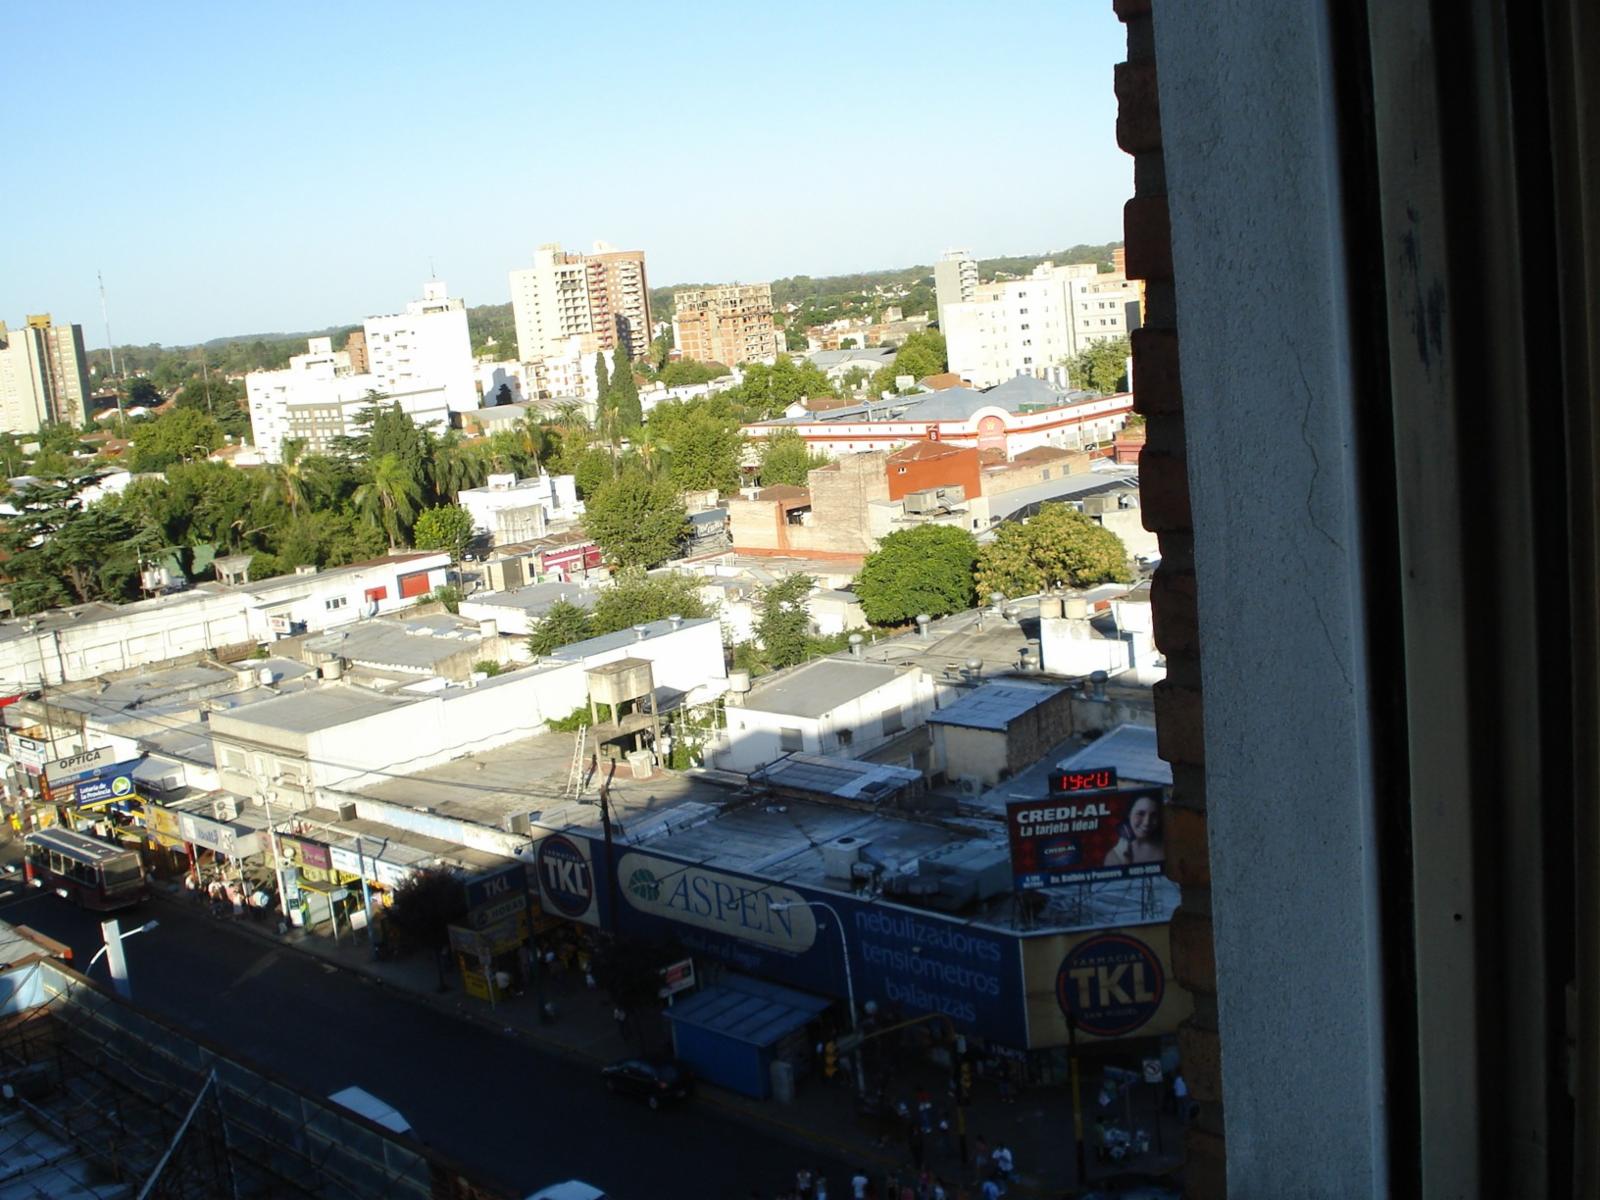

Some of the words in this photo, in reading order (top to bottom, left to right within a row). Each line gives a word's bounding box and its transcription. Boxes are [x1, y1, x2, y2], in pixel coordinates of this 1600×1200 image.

[60, 752, 101, 769] OPTICA
[1017, 803, 1111, 824] CREDI-AL
[1020, 825, 1032, 837] La
[1035, 821, 1070, 836] tarjeta
[1072, 818, 1098, 832] ideal
[482, 875, 511, 897] TKL
[543, 857, 589, 898] TKL
[667, 874, 794, 938] ASPEN
[855, 910, 1001, 961] nebulizadores
[1072, 952, 1145, 967] FARMACIAS
[884, 976, 977, 1022] balanzas
[1069, 962, 1154, 1009] TKL
